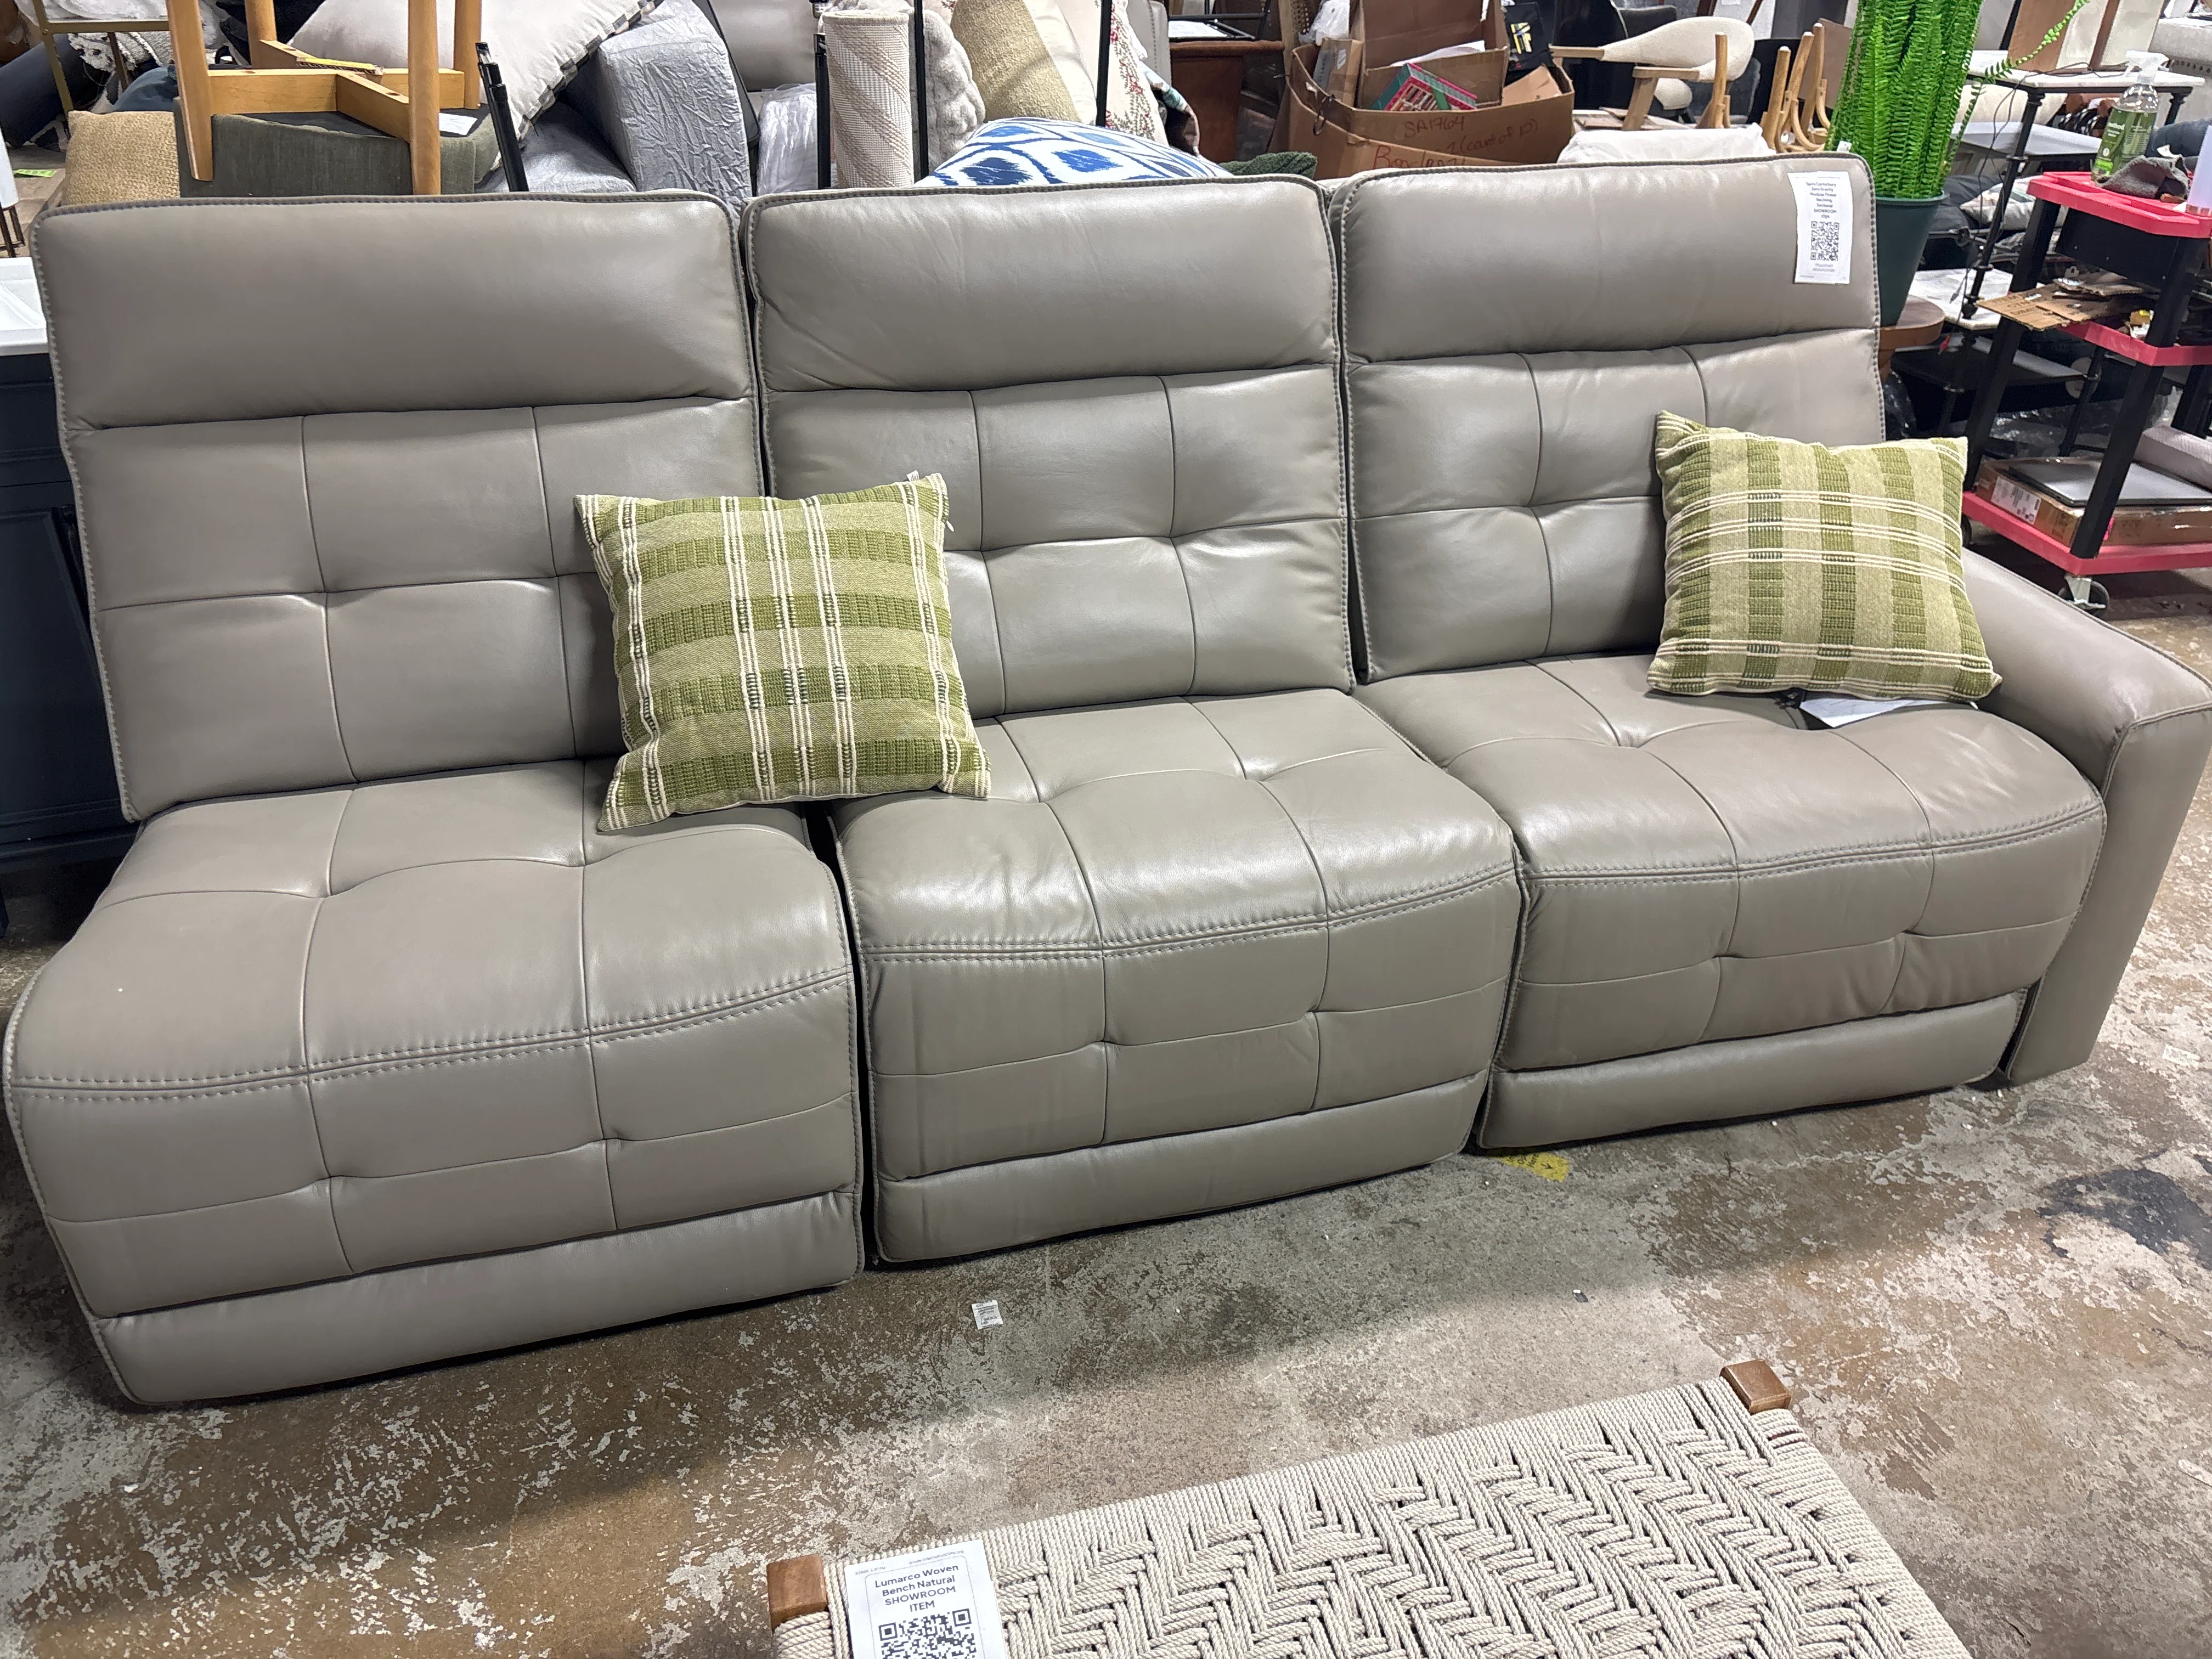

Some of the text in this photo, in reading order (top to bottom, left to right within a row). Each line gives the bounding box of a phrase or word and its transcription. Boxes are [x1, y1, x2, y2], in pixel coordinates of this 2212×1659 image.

[875, 1565, 959, 1588] Lumarco Woven
[882, 1575, 955, 1596] Bench Natural
[885, 1586, 956, 1606] SHOWROOM
[910, 1600, 935, 1612] ITEM
